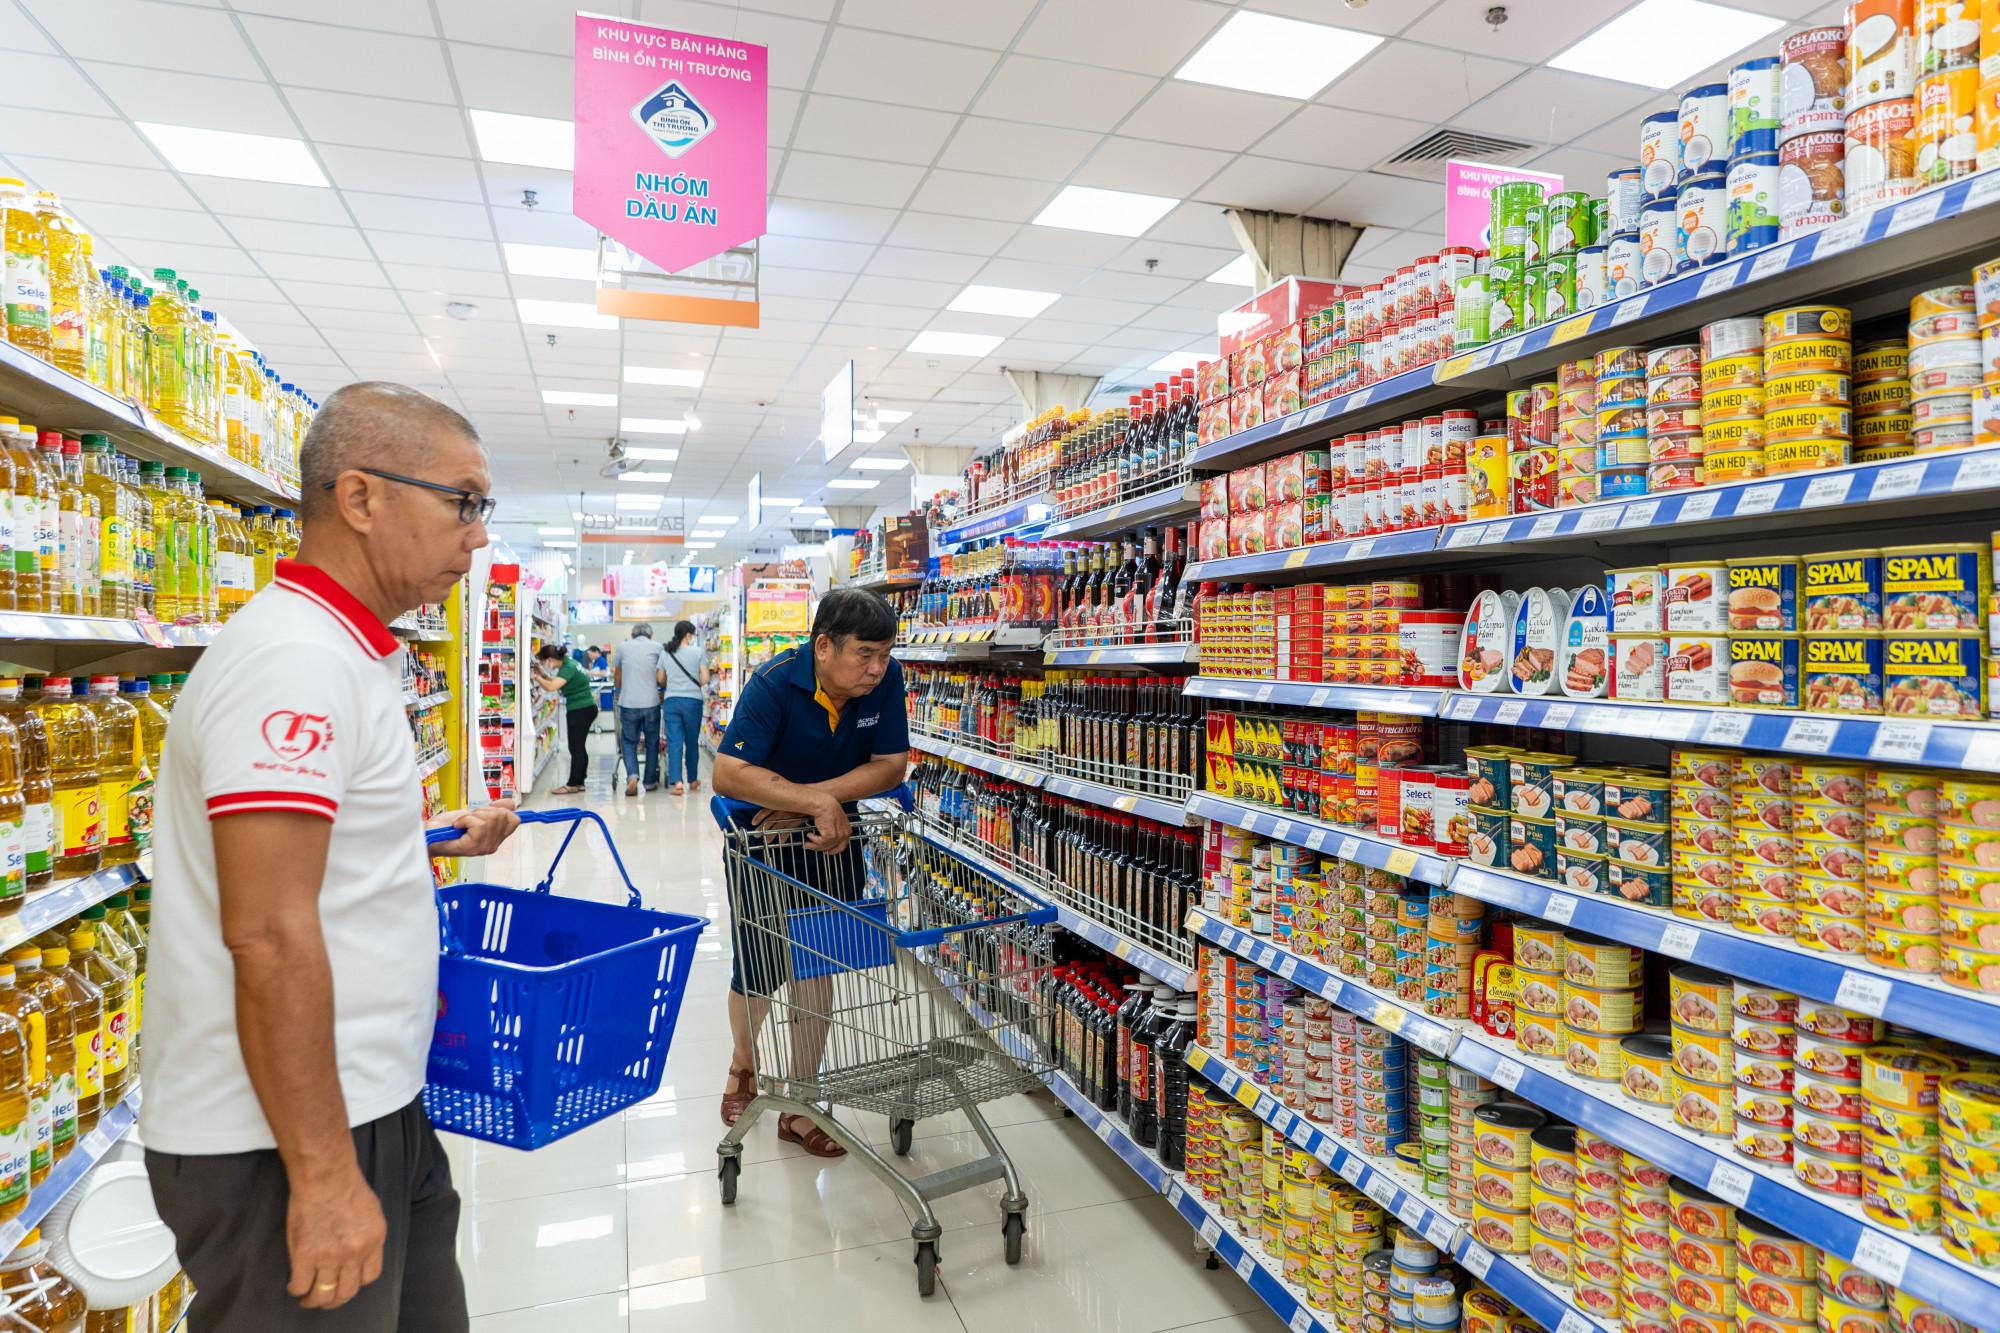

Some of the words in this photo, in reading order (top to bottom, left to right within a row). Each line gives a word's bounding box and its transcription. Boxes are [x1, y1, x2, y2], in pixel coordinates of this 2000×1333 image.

[597, 26, 631, 43] KHU
[633, 31, 667, 48] VỰC
[670, 35, 702, 53] BÁN
[705, 40, 748, 61] HÀNG
[1818, 42, 1836, 50] MILK
[593, 46, 630, 64] BÌNH
[634, 49, 656, 68] ỔN
[660, 57, 684, 75] THỊ
[687, 59, 752, 82] TRƯỜNG
[1890, 119, 1911, 128] MILK
[1816, 144, 1834, 153] MILK
[1459, 169, 1480, 181] KHU
[1482, 170, 1502, 184] VỰC
[635, 172, 709, 198] NHÓM
[1457, 184, 1480, 198] BÌNH
[626, 195, 677, 222] DẦU
[683, 201, 718, 226] ĂN
[1795, 344, 1816, 359] GAN
[1819, 343, 1838, 358] HEO
[1861, 355, 1879, 371] GAN
[1881, 354, 1901, 369] HEO
[1704, 366, 1717, 379] GAN
[1719, 364, 1736, 377] HEO
[1774, 382, 1792, 397] GAN
[1796, 380, 1814, 395] HEO
[1861, 388, 1880, 403] GAN
[1884, 387, 1903, 402] HEO
[1708, 396, 1723, 409] GAN
[1724, 394, 1742, 407] HEO
[1448, 424, 1472, 432] Select
[1776, 414, 1794, 430] GAN
[1797, 412, 1816, 428] HEO
[1866, 420, 1885, 435] GAN
[1889, 418, 1908, 433] HEO
[1708, 427, 1723, 441] GAN
[1724, 426, 1742, 439] HEO
[1778, 446, 1797, 460] GAN
[1800, 444, 1820, 458] HEO
[1711, 457, 1726, 471] GAN
[1728, 455, 1746, 468] HEO
[1807, 561, 1862, 585] SPAM
[1887, 556, 1956, 581] SPAM
[1730, 567, 1779, 588] SPAM
[1668, 587, 1687, 597] BACON
[1670, 594, 1685, 602] GRILL
[1478, 629, 1494, 639] Ham
[1528, 626, 1545, 635] Ham
[1583, 634, 1600, 643] Ham
[1731, 640, 1781, 661] SPAM
[1808, 641, 1863, 662] SPAM
[1888, 641, 1958, 663] SPAM
[1669, 656, 1688, 665] BACON
[1671, 663, 1687, 671] GRILL
[1406, 789, 1432, 799] Select
